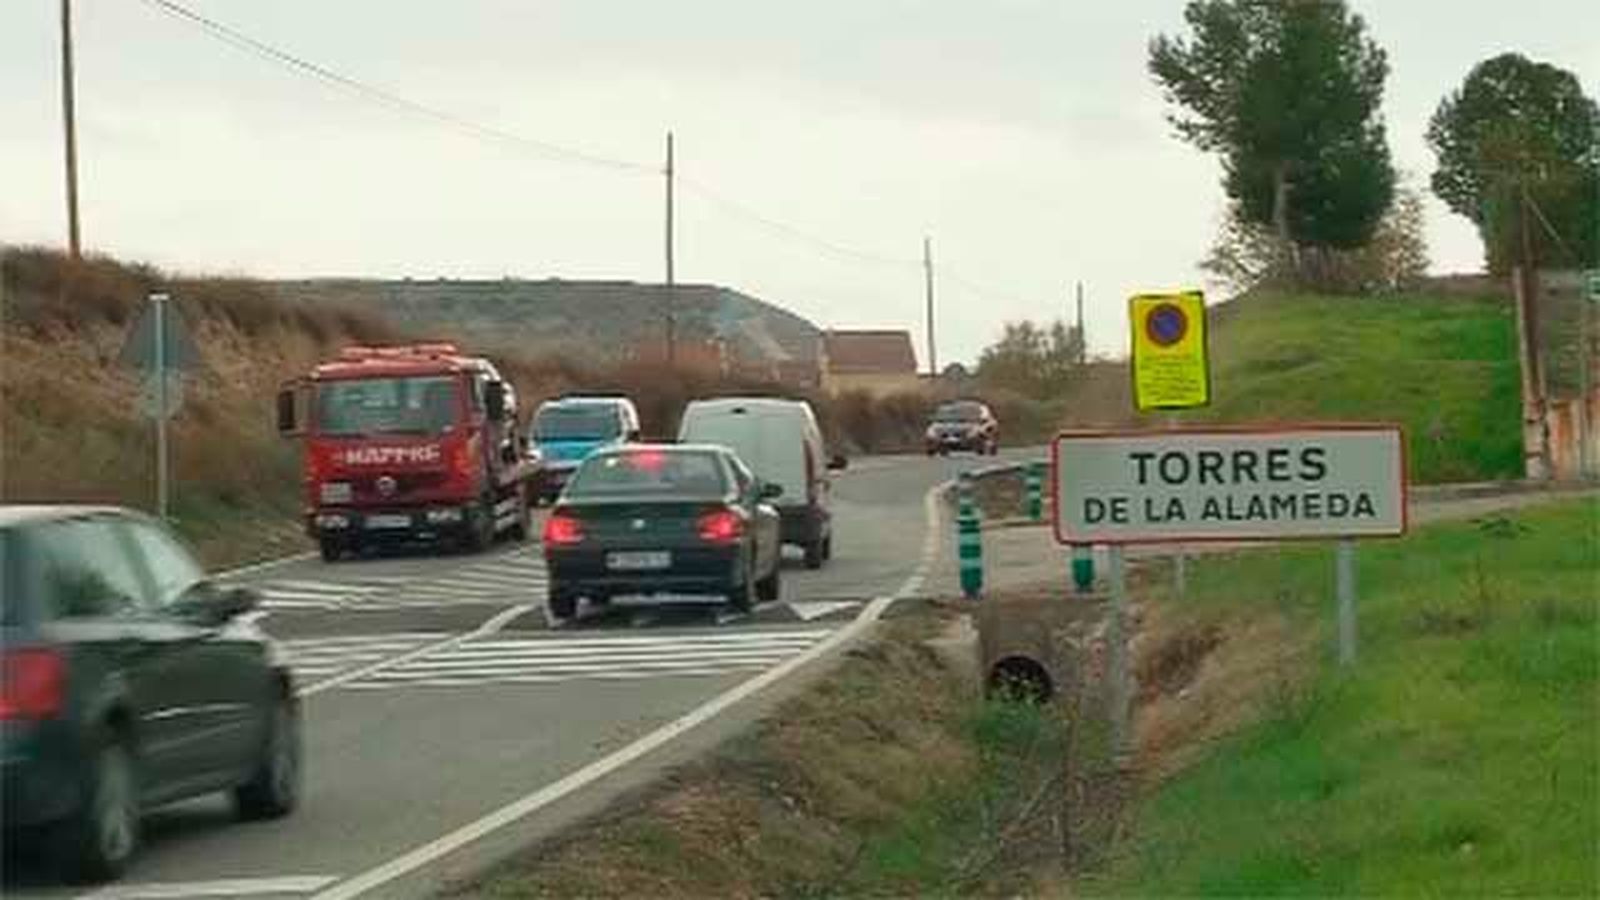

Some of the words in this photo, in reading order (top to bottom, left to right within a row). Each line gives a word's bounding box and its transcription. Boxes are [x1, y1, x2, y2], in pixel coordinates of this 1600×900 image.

[1129, 448, 1327, 485] TORRES
[1084, 497, 1130, 524] DE
[1145, 496, 1187, 523] LA
[1200, 493, 1376, 521] ALAMEDA
